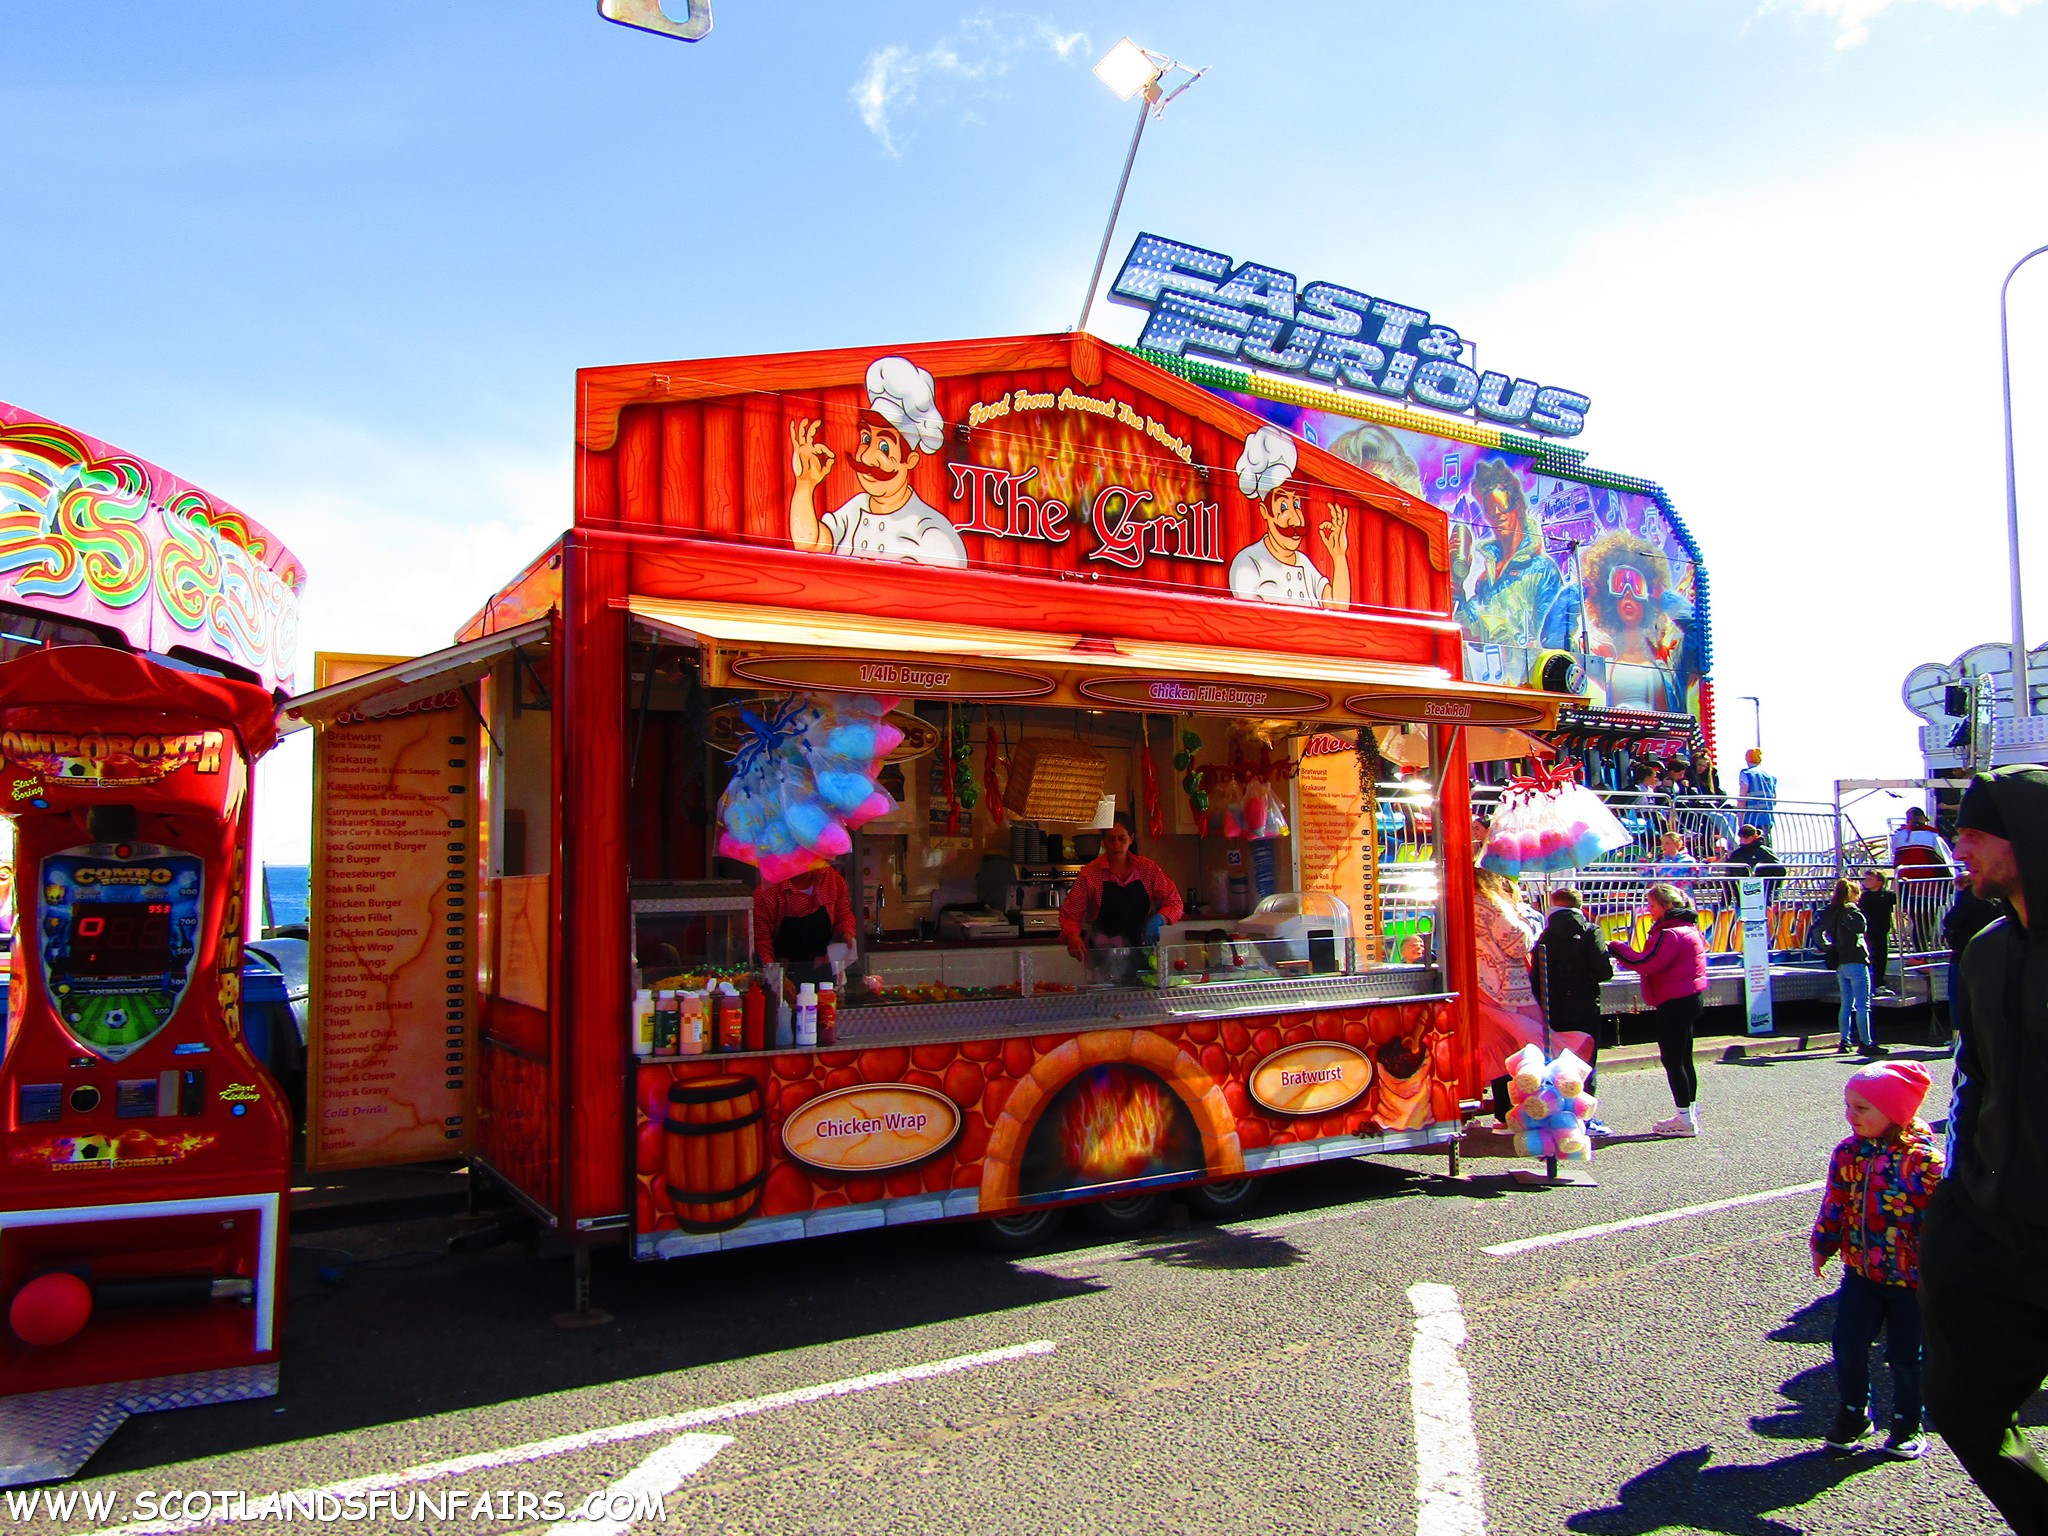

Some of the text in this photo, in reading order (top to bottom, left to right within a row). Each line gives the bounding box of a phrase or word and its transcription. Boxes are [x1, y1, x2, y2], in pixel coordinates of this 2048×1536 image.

[1107, 230, 1464, 362] FAST &
[1138, 290, 1591, 440] FURIOUS
[968, 388, 1193, 463] Food From Around The World
[948, 462, 1224, 568] The Grill
[859, 664, 950, 688] 1/4lb Burger
[1149, 683, 1267, 706] Chicken Fillet Burger
[1425, 702, 1471, 718] Steak Roll
[327, 731, 383, 741] Bratwurst
[327, 754, 378, 765] Krakauer
[12, 776, 39, 788] Start
[11, 786, 45, 801] Boxing
[326, 808, 434, 819] Currywurst, Bratwurst or
[327, 818, 407, 829] Krakauer Sausage
[326, 855, 381, 866] 4oz Burger
[75, 867, 173, 884] COMBO
[325, 869, 396, 880] Cheeseburger
[180, 888, 198, 896] 900
[325, 883, 376, 894] Steak Roll
[148, 903, 172, 914] 953
[325, 898, 402, 910] Chicken Burger
[180, 918, 197, 926] 700
[325, 913, 393, 923] Chicken Fillet
[325, 927, 418, 938] 4 Chicken Goujons
[325, 943, 394, 954] Chicken Wrap
[325, 958, 386, 969] Onion Rings
[324, 973, 399, 984] Potato Wedges
[324, 989, 366, 1000] Hot Dog
[324, 1001, 413, 1015] Piggy in a Blanket
[324, 1018, 351, 1028] Chips
[324, 1029, 397, 1041] Bucket of Chips
[323, 1043, 398, 1055] Seasoned Chips
[323, 1071, 396, 1084] Chips & Cheese
[1280, 1064, 1343, 1088] Bratwurst
[227, 1083, 257, 1093] Start
[323, 1086, 389, 1099] Chips & Gravy
[219, 1091, 261, 1102] Kicking
[323, 1104, 388, 1119] Cold Drinks
[815, 1111, 928, 1139] Chicken Wrap
[322, 1126, 345, 1136] Cans
[322, 1140, 356, 1151] Bottles
[51, 1155, 176, 1172] DOUBLE COMBAT
